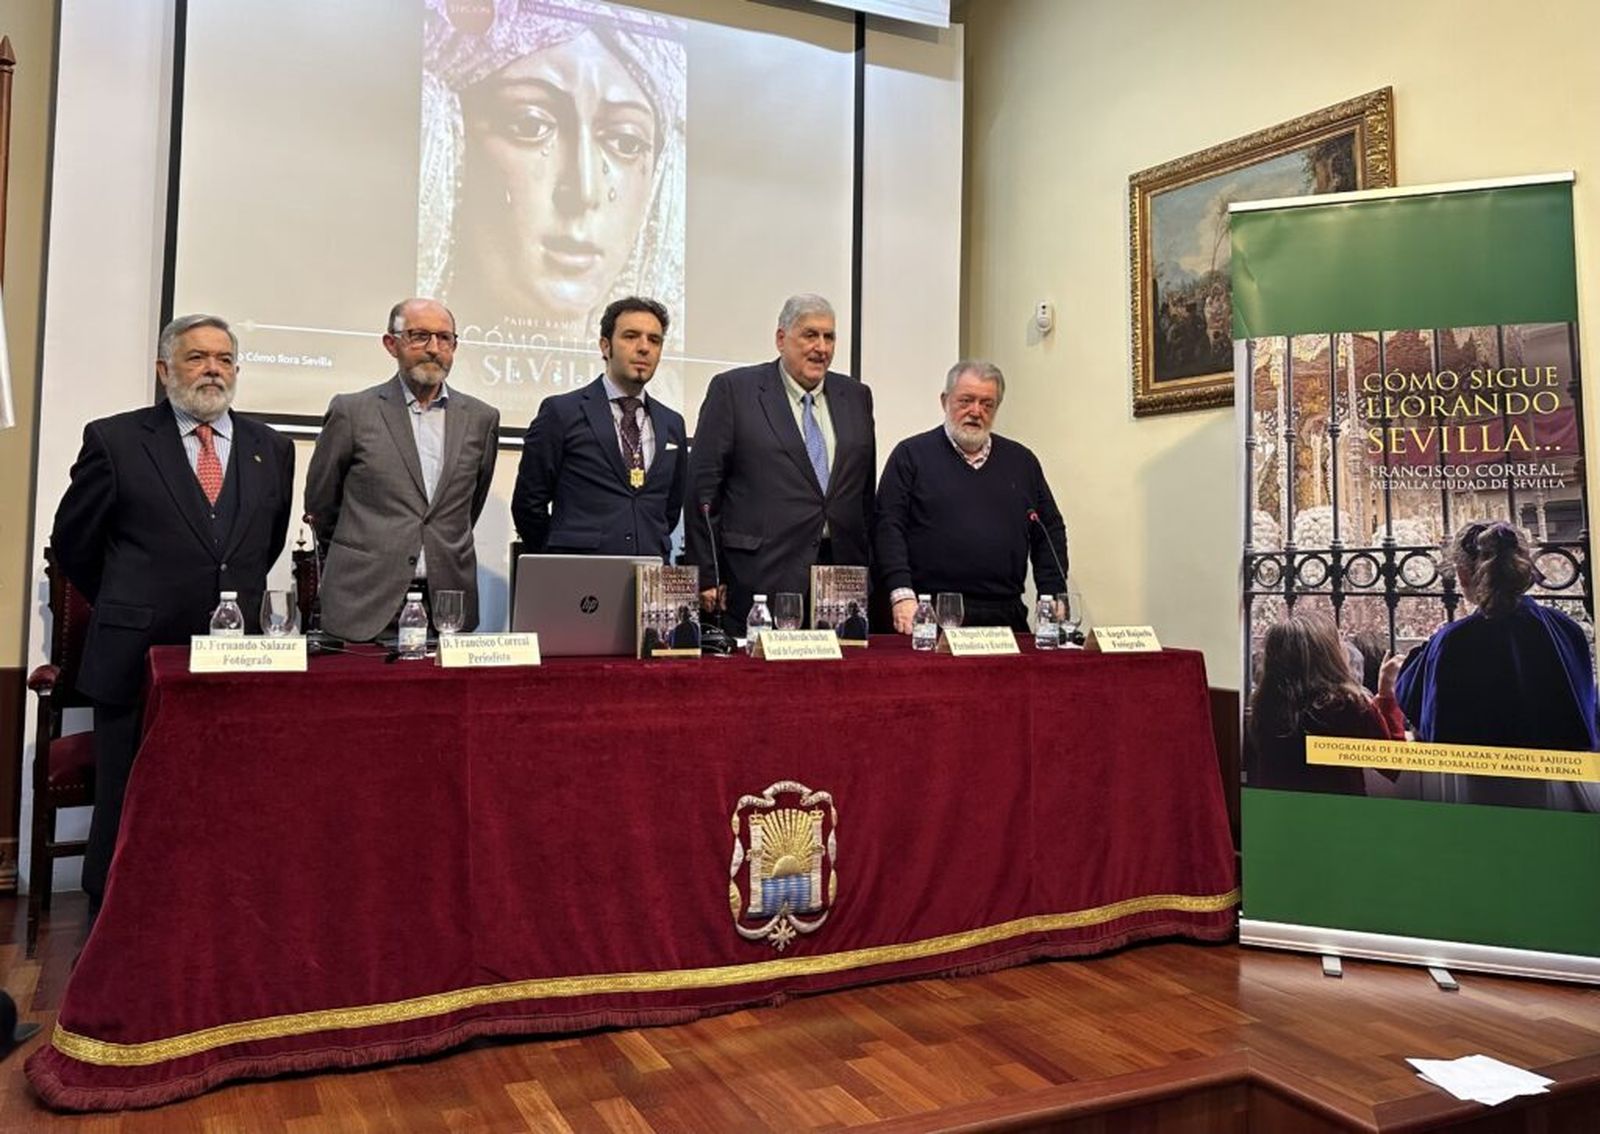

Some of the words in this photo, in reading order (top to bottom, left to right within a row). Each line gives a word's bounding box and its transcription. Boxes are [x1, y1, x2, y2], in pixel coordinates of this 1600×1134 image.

[463, 323, 548, 353] CÓMO
[246, 352, 276, 363] Cómo
[301, 355, 333, 368] Sevilla
[1363, 368, 1459, 393] CÓMO
[1470, 367, 1559, 390] SIGUE
[1367, 391, 1561, 419] LLORANDO
[1368, 424, 1562, 454] SEVILLA...
[1370, 464, 1470, 479] FRANCISCO
[1475, 462, 1564, 479] CORREAL,
[1371, 479, 1429, 490] MEDALLA
[1432, 479, 1487, 490] CIUDAD
[1491, 479, 1509, 490] DE
[1513, 478, 1566, 489] SEVILLA
[581, 596, 598, 613] hp
[195, 639, 206, 651] D.
[209, 640, 257, 651] Fernando
[260, 640, 296, 651] Salazar
[443, 639, 453, 649] D.
[455, 637, 496, 648] Francisco
[223, 654, 273, 667] Fotógrafo
[468, 652, 511, 664] Periodista
[1314, 741, 1376, 753] FOTOGRAFÍAS
[1380, 745, 1391, 753] DE
[1395, 746, 1448, 757] FERNANDO
[1450, 749, 1492, 760] SALAZAR
[1495, 752, 1501, 760] Y
[1503, 752, 1536, 762] ÁNGEL
[1540, 755, 1582, 765] BAJUELO
[1338, 753, 1388, 763] PRÓLOGOS
[1392, 756, 1402, 764] DE
[1406, 757, 1435, 767] PABLO
[1439, 760, 1488, 770] BORRALLO
[1492, 762, 1498, 771] Y
[1501, 763, 1541, 773] MARINA
[1544, 765, 1583, 775] BERNAL
